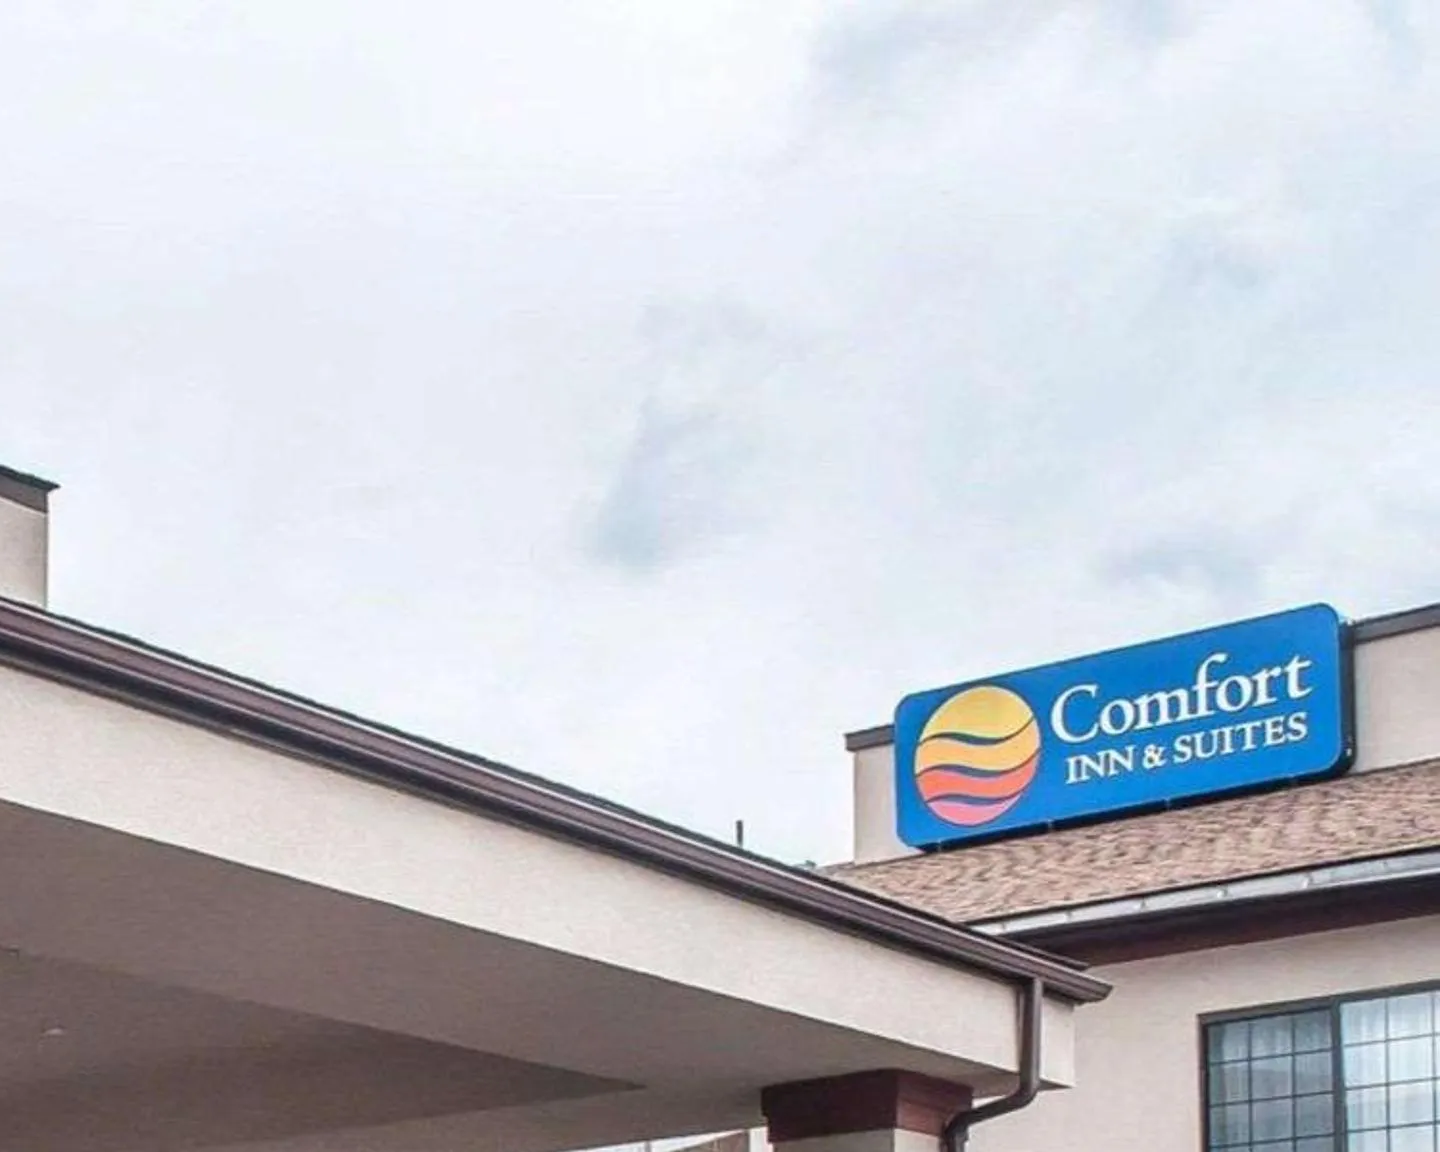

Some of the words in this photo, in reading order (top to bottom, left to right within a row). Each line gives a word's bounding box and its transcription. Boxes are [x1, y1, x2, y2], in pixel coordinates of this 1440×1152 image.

[1050, 653, 1313, 743] Comfort
[1065, 744, 1136, 785] INN
[1142, 743, 1168, 770] &
[1173, 711, 1308, 764] SUITES
